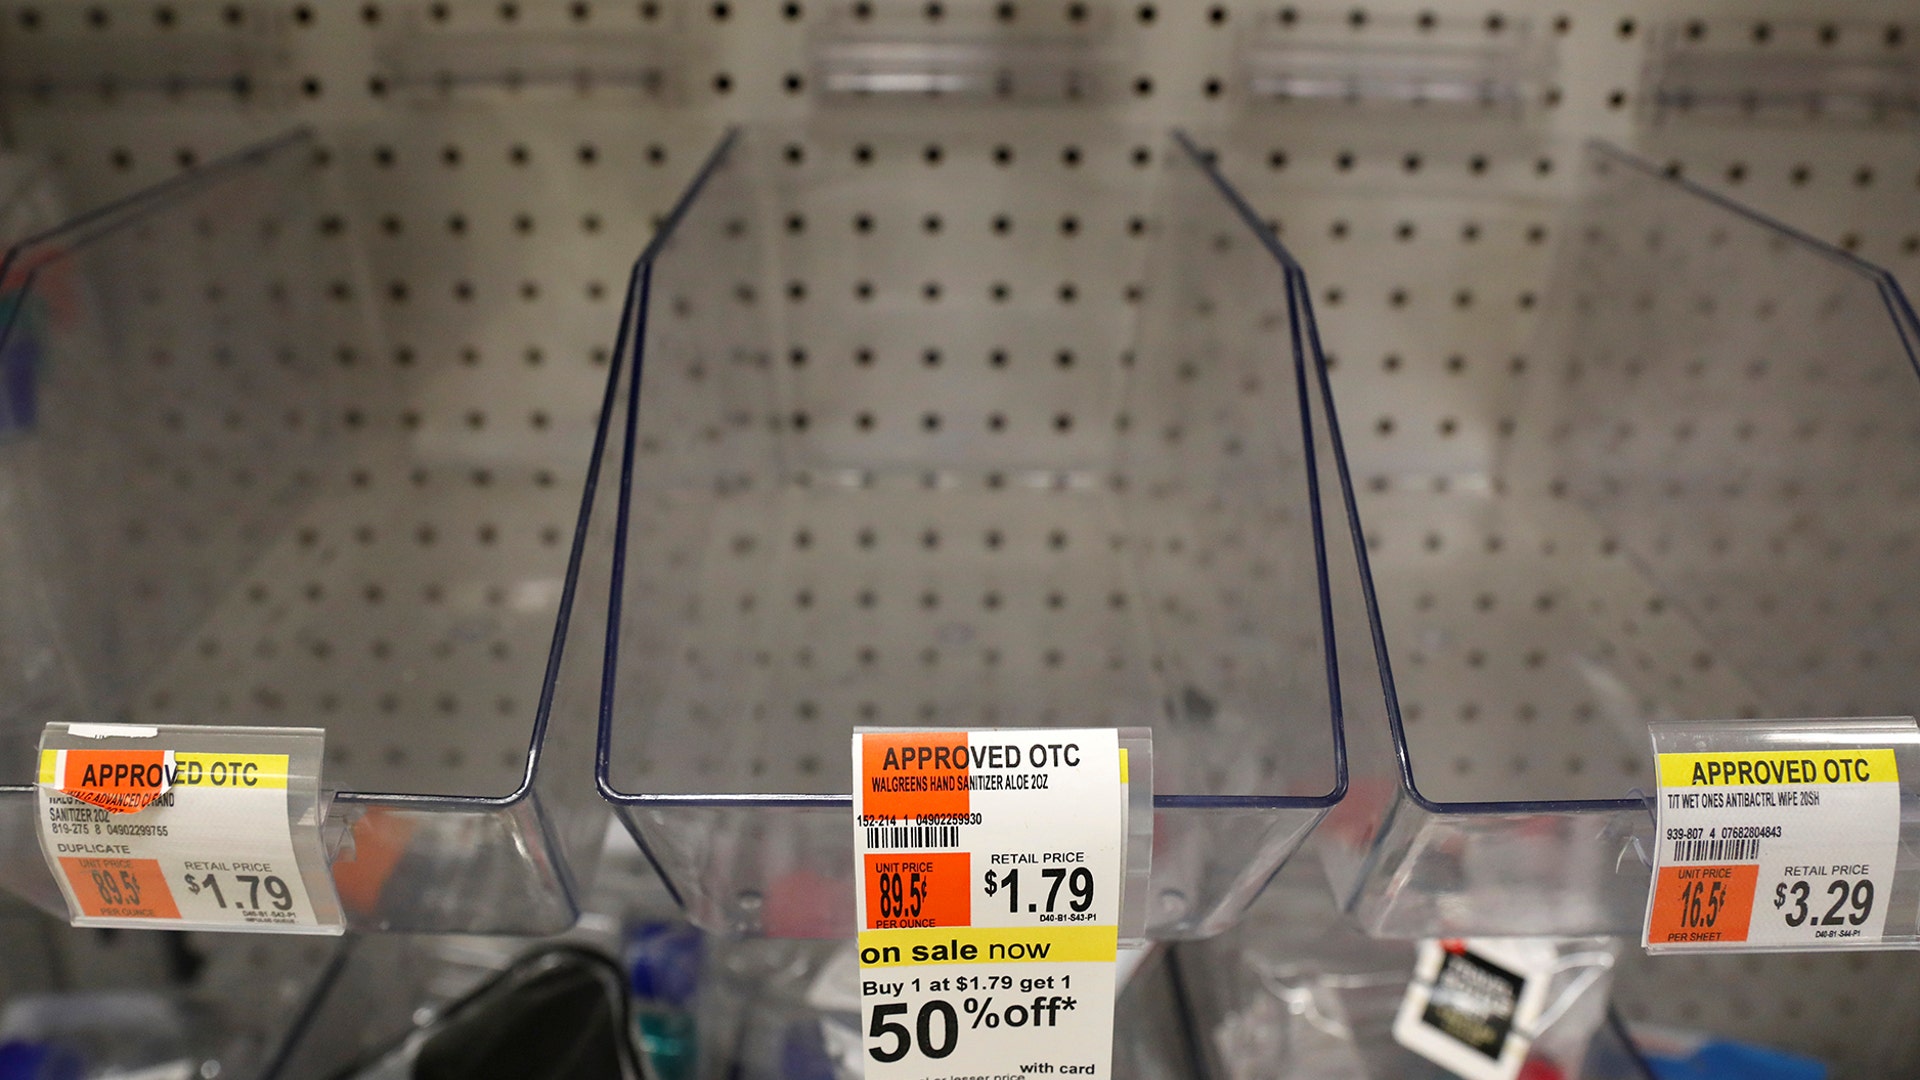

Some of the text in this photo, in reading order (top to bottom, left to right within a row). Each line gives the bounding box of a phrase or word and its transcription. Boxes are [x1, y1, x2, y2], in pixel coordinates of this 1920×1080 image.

[883, 743, 1081, 771] APPROVED OTC
[82, 761, 257, 787] APPROVED OTC
[1692, 758, 1870, 785] APPROVED OTC
[872, 776, 928, 793] WALGREENS
[930, 776, 955, 791] HAND
[958, 775, 1003, 791] SANITIZER
[1005, 774, 1029, 790] ALOE
[1682, 794, 1700, 809] WET
[1702, 793, 1723, 808] ONES
[1726, 792, 1776, 807] ANTIBACTRL
[1778, 792, 1799, 807] WIPE
[50, 808, 92, 822] SANITIZER
[856, 813, 982, 827] 152-214 1 04902259930
[52, 823, 168, 836] 819-275 8 04902299755
[1667, 826, 1782, 840] 939-807 4 07682804843
[57, 844, 130, 854] DUPLICATE
[991, 852, 1084, 864] RETAIL PRICE
[184, 861, 272, 872] RETAIL PRICE
[875, 862, 933, 873] UNIT PRICE
[1678, 868, 1732, 878] UNIT PRICE
[1784, 865, 1869, 876] RETAIL PRICE
[183, 873, 293, 911] $1.79
[984, 867, 1094, 913] $1.79
[1774, 879, 1874, 927] $3.29
[876, 918, 936, 929] PER OUNCE
[1668, 932, 1722, 941] PER SHEET
[861, 939, 1051, 964] on sale now
[863, 975, 1070, 997] Buy 1 at $1.79 get 1
[1020, 1063, 1095, 1074] with card
